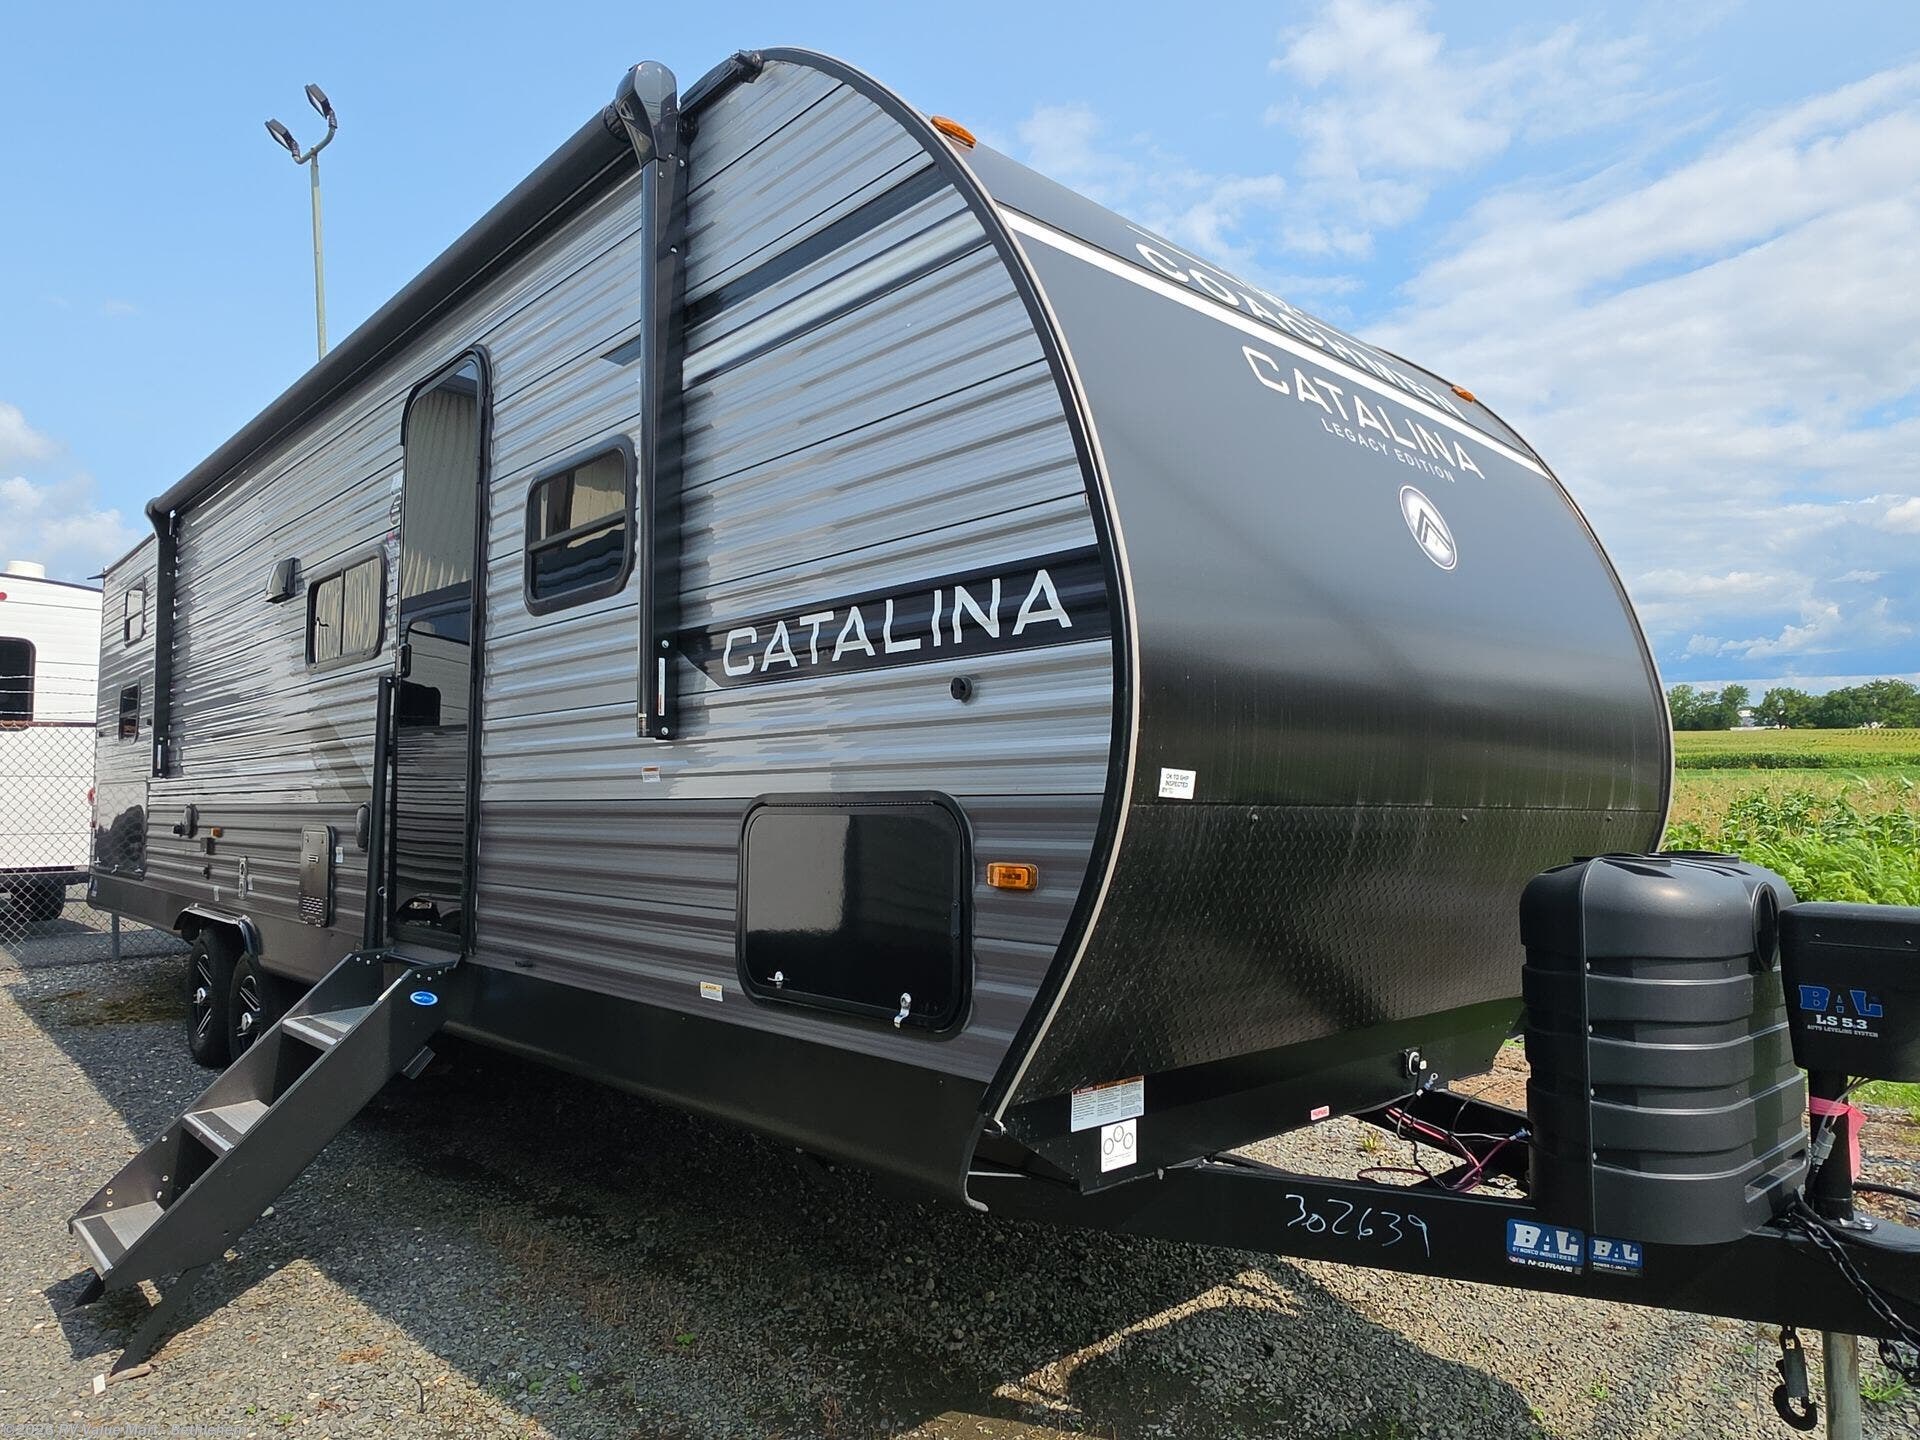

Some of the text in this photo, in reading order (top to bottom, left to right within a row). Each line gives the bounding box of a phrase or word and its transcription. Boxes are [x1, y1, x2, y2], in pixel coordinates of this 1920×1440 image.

[1135, 243, 1467, 421] COACHMEN
[1241, 345, 1486, 480] CATALINA
[1321, 418, 1455, 483] LEGACY EDITION
[723, 569, 1073, 677] CATALINA
[1815, 1014, 1838, 1026] LS
[1823, 1026, 1853, 1035] LEVELING
[1853, 1030, 1879, 1038] SYSTEM
